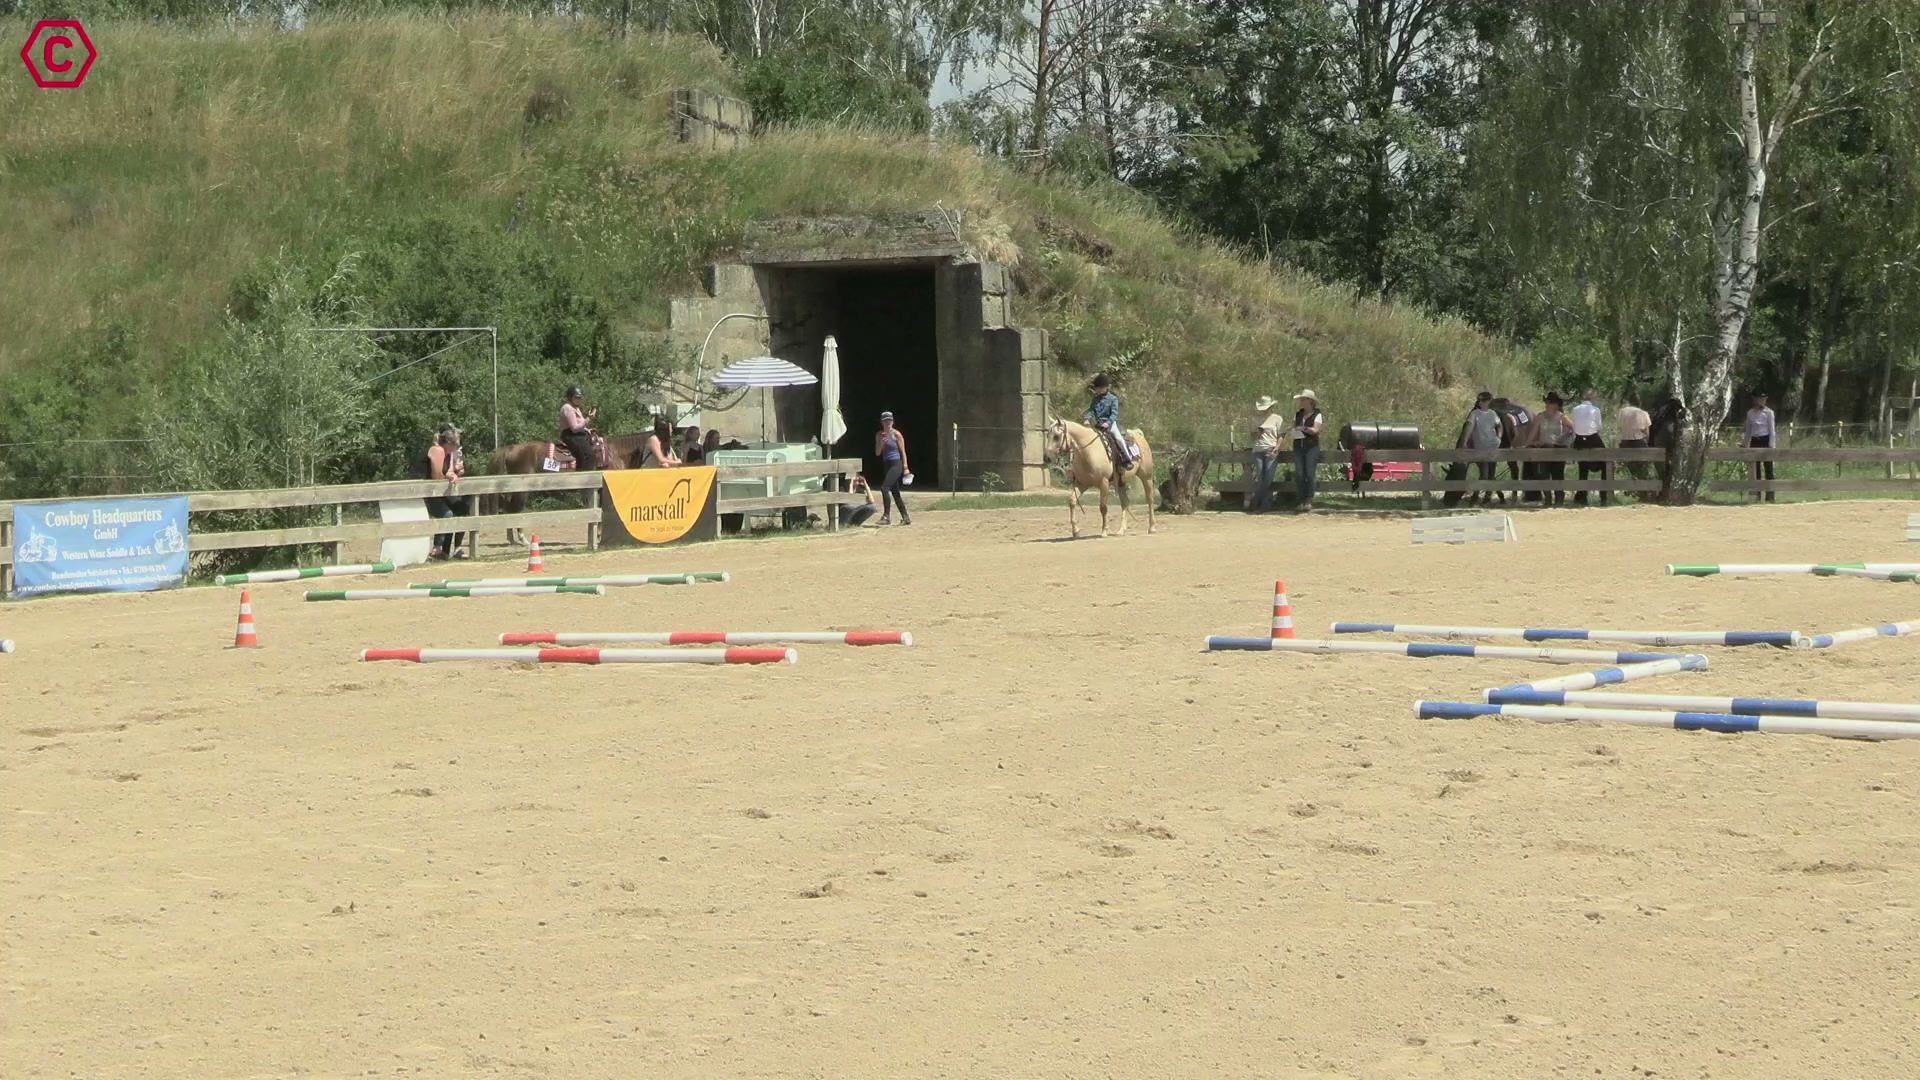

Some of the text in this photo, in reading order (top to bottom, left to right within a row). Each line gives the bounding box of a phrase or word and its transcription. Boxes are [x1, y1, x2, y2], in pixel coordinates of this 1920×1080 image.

[45, 508, 162, 529] Cowboy Headquarters
[630, 498, 684, 522] marstall
[94, 528, 118, 540] GmbH
